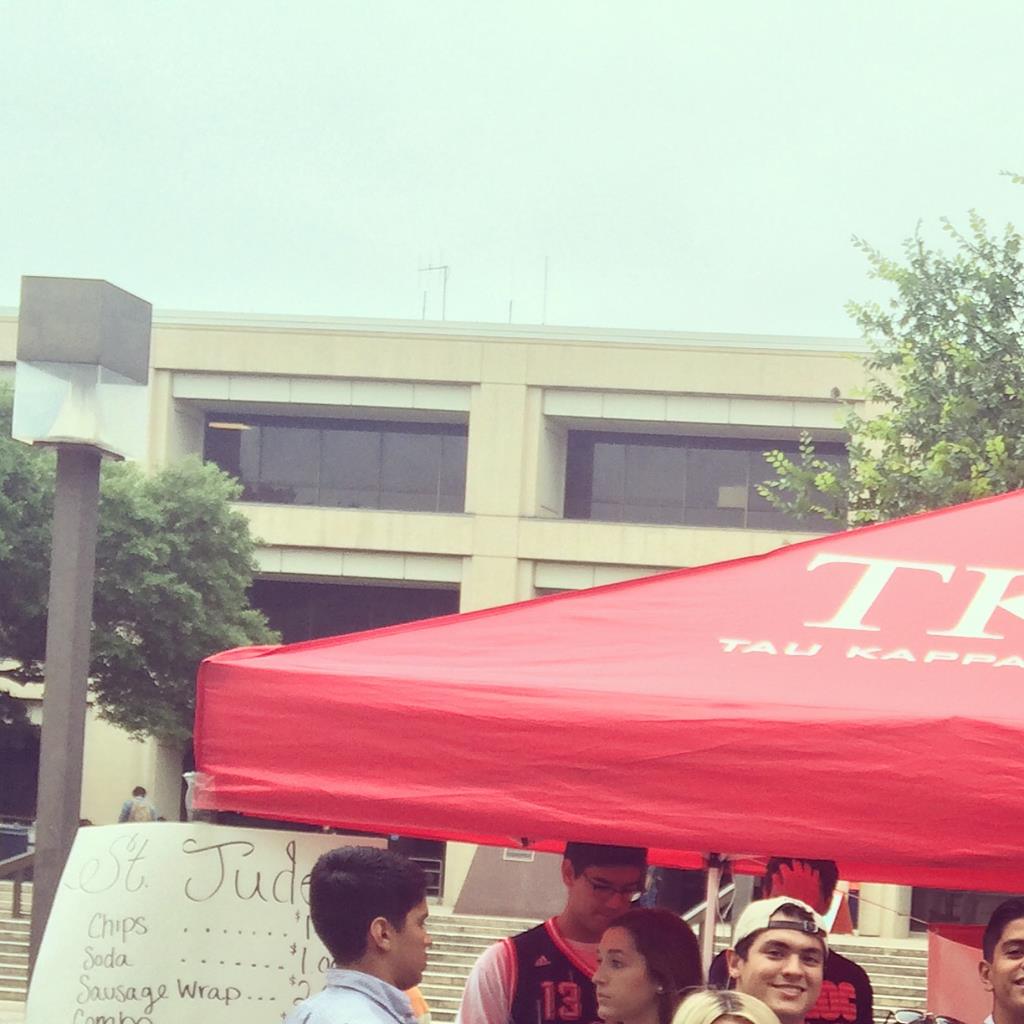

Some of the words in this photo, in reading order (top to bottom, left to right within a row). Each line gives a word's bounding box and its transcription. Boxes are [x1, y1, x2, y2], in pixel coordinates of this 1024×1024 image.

[718, 637, 823, 657] TAU
[88, 911, 148, 943] Chips
[82, 945, 135, 970] Soda
[76, 974, 169, 1015] Sausage
[176, 978, 242, 1006] Wrap
[541, 981, 580, 1020] 13
